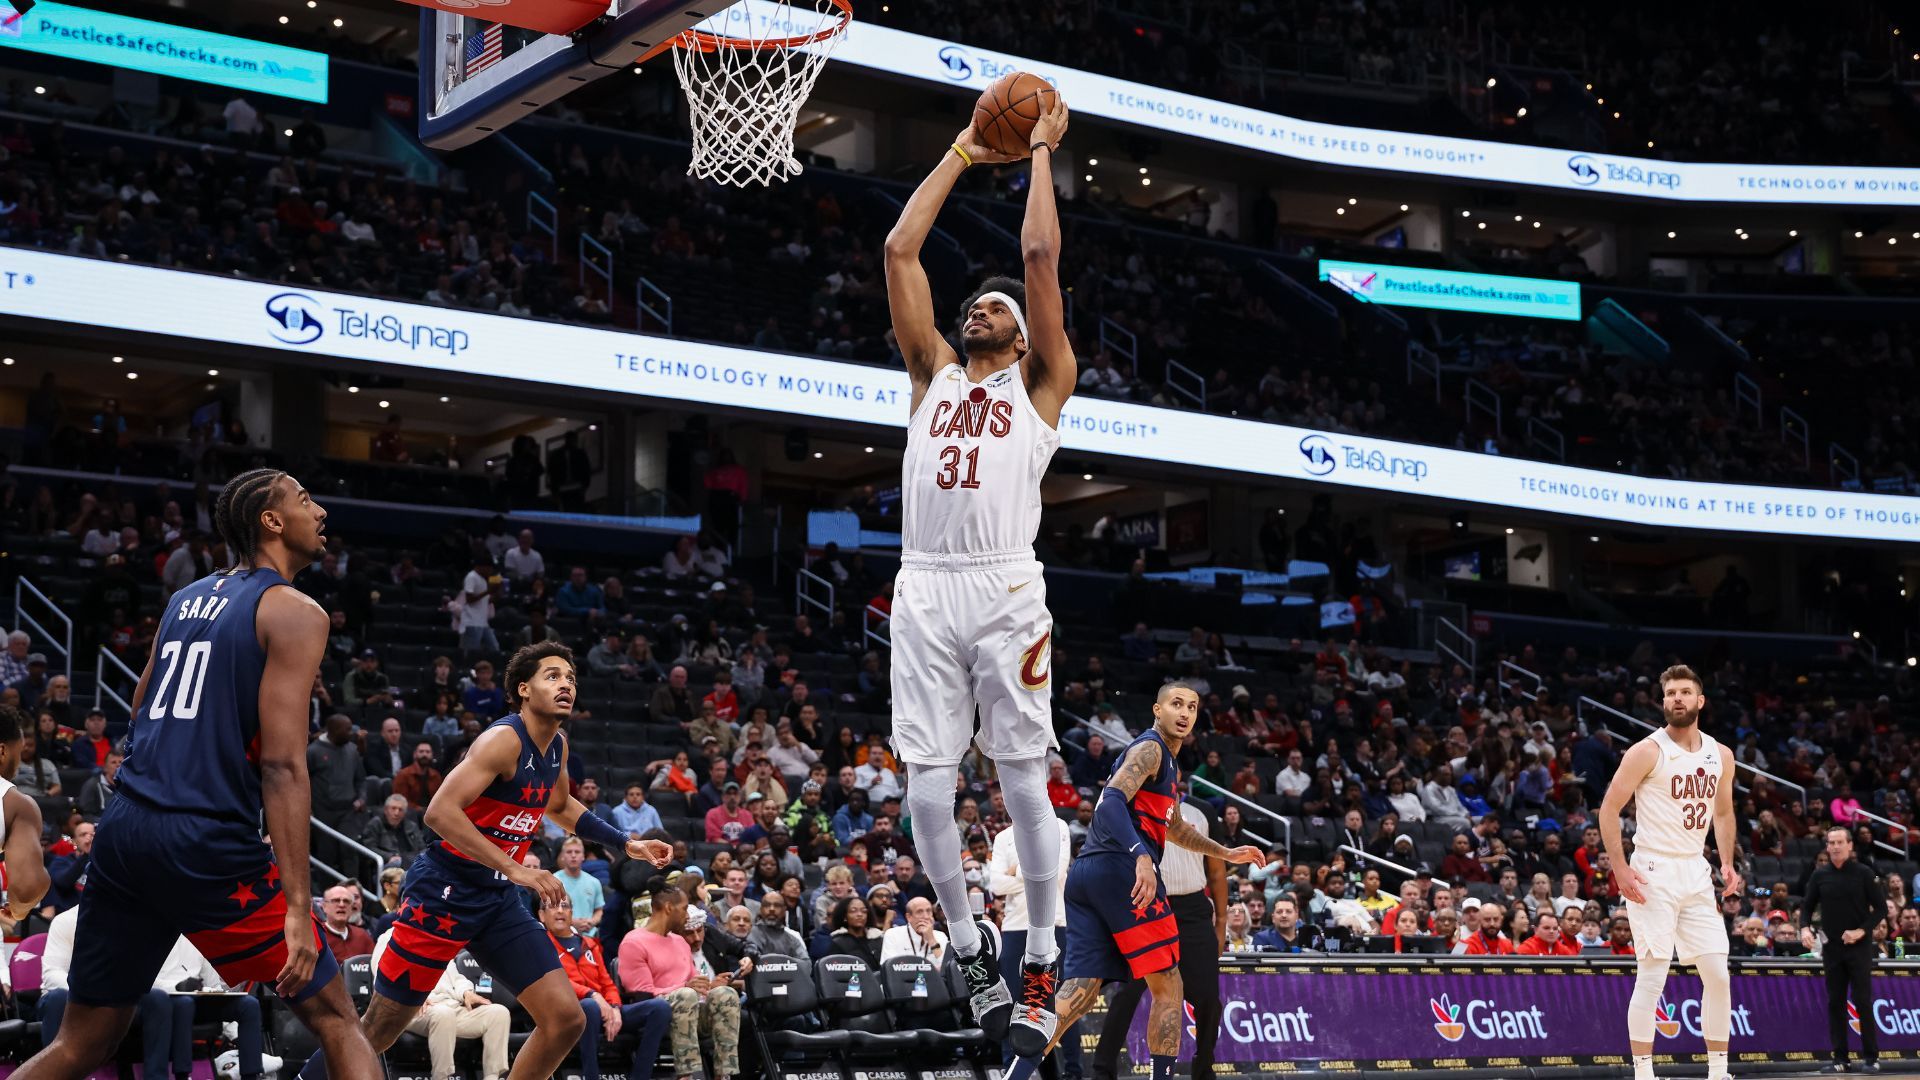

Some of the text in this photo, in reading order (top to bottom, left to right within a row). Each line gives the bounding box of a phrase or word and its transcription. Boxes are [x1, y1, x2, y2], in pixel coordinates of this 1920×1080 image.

[39, 19, 259, 72] PracticeSafeChecks.com
[1108, 91, 1203, 121] TECHNOLOGY
[1210, 114, 1264, 136] MOVING
[1270, 128, 1285, 139] AT
[1291, 132, 1314, 147] THE
[1323, 137, 1370, 153] SPEED
[1377, 143, 1396, 155] OF
[1738, 176, 1920, 192] TECHNOLOGY MOVING
[1384, 277, 1532, 303] PracticeSafeChecks.com
[333, 307, 469, 356] TekSynap
[615, 353, 898, 406] TECHNOLOGY MOVING AT
[929, 399, 1013, 439] CAVS
[936, 445, 981, 490] 31
[1341, 445, 1428, 482] TekSynap
[1520, 476, 1920, 525] TECHNOLOGY MOVING AT THE SPEED OF THOUGH
[149, 640, 212, 720] 20
[1671, 774, 1718, 800] CAVS
[1682, 802, 1707, 830] 32
[755, 960, 798, 973] wizards
[825, 960, 867, 973] wizards
[892, 960, 932, 973] wizards
[1223, 1000, 1315, 1043] Giant
[1466, 999, 1548, 1040] Giant
[1681, 998, 1755, 1037] Gnt
